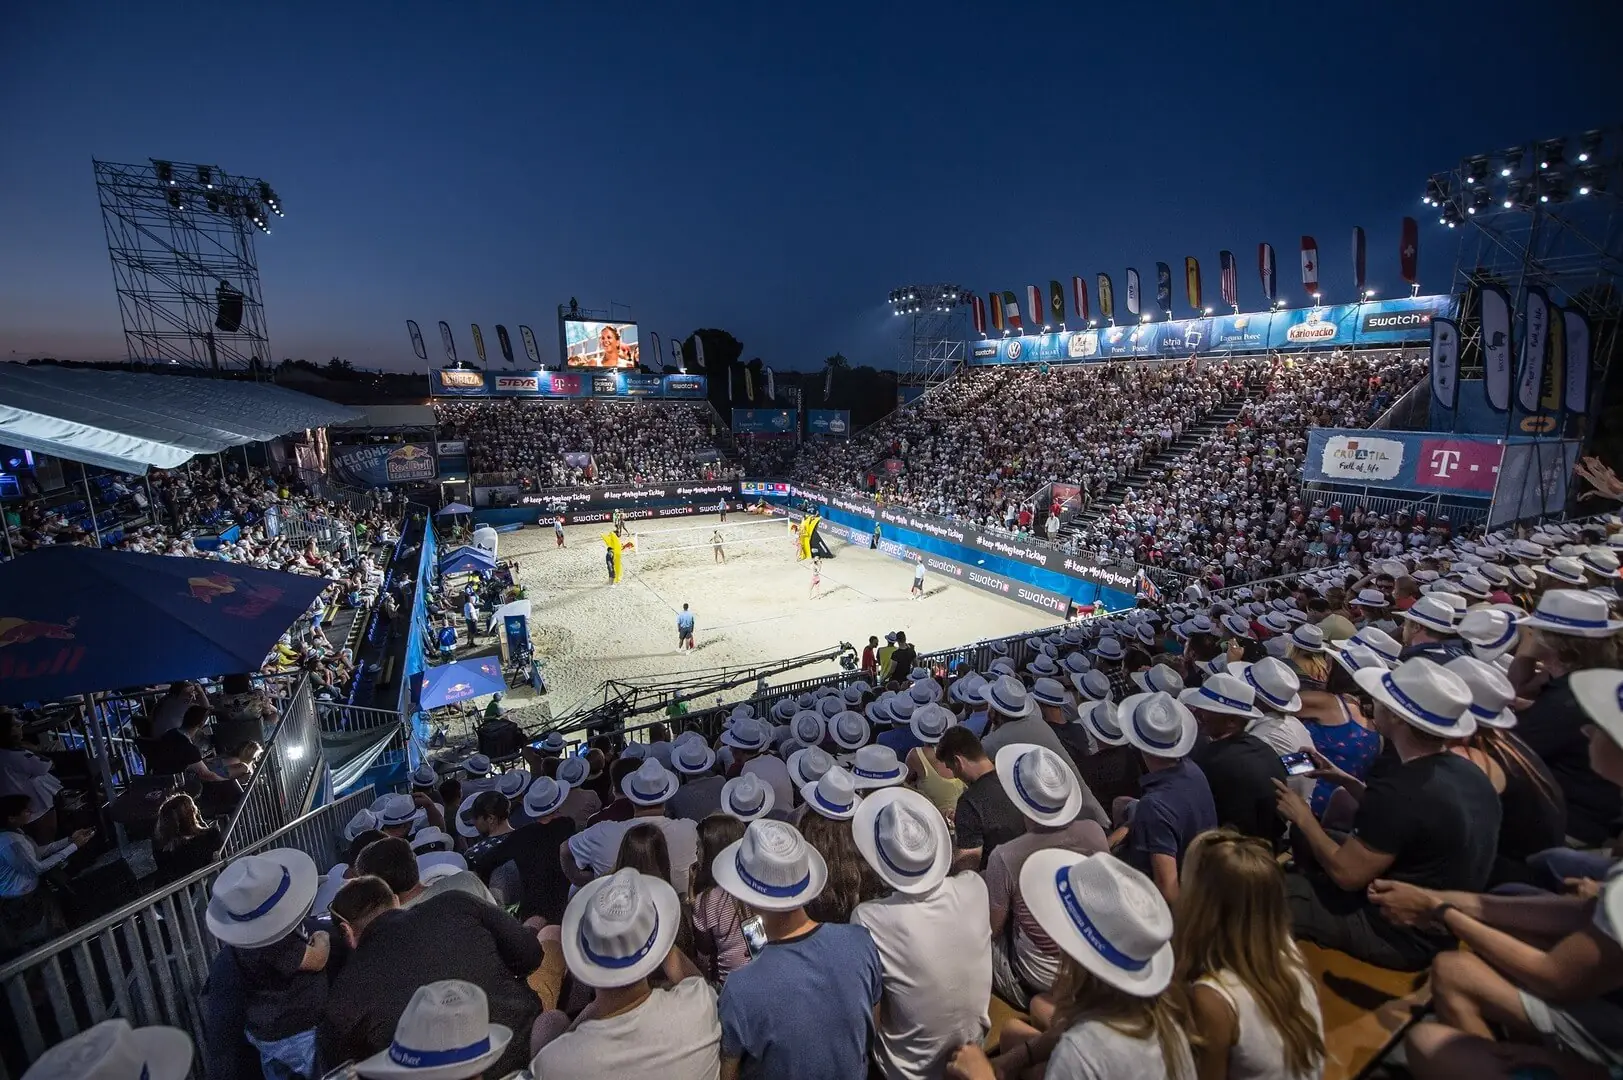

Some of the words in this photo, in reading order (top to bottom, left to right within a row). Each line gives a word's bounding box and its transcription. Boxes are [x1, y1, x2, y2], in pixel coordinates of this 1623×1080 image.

[1368, 314, 1421, 327] swatch
[499, 378, 535, 387] STEYR
[332, 446, 389, 469] WELCOME
[1333, 449, 1389, 461] CROATIA
[349, 464, 361, 473] TO
[364, 459, 380, 470] THE
[389, 460, 410, 473] Red
[411, 459, 431, 471] Bull
[1339, 462, 1354, 471] Full
[1432, 450, 1460, 478] T
[573, 513, 605, 523] swatch
[660, 507, 687, 516] swatch
[928, 558, 956, 574] swatch
[969, 571, 1004, 590] swatch
[1018, 588, 1060, 610] swatch
